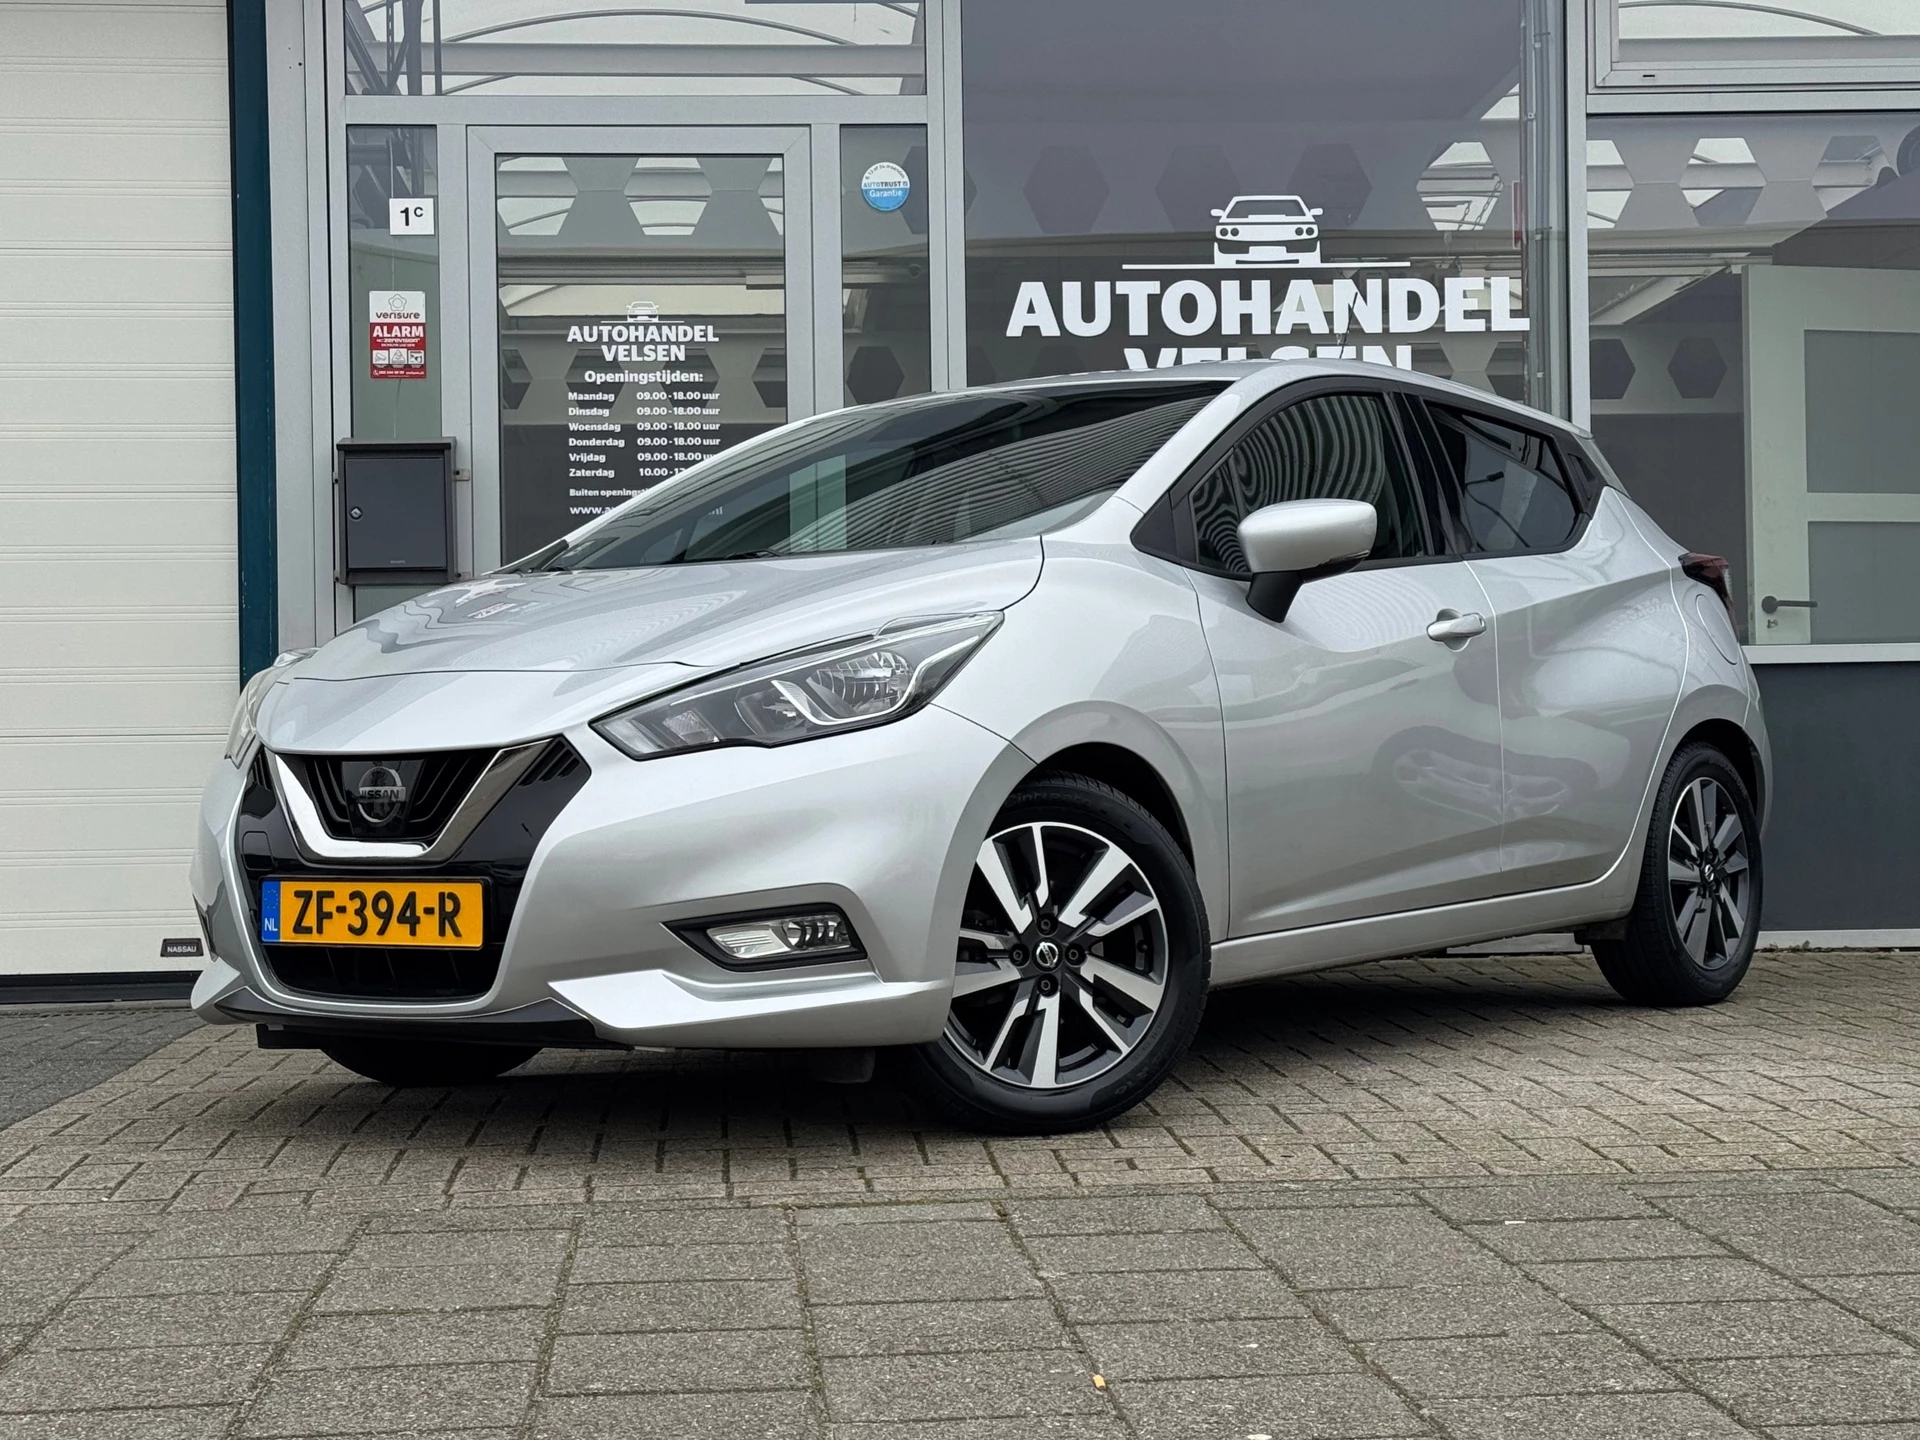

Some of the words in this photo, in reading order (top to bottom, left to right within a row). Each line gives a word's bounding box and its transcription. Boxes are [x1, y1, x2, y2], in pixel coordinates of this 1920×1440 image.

[869, 189, 903, 198] Garantie
[1006, 276, 1531, 337] AUTOHANDEL
[375, 311, 421, 319] verisure
[372, 325, 424, 338] ALARM
[567, 325, 720, 342] AUTOHANDEL
[601, 344, 686, 362] VELSEN
[584, 370, 704, 385] Openingstijden:
[568, 392, 615, 402] Maandag
[636, 391, 667, 400] 09.00
[673, 391, 701, 400] 18.00
[568, 407, 610, 417] Dinsdag
[636, 406, 667, 415] 09.00
[673, 406, 701, 415] 18.00
[569, 422, 621, 432] Woensdag
[636, 422, 667, 430] 09.00
[673, 422, 701, 430] 18.00
[568, 438, 625, 448] Donderdag
[636, 437, 667, 445] 09.00
[673, 437, 701, 445] 18.00
[569, 453, 606, 463] Vrijdag
[637, 452, 668, 461] 09.00
[674, 452, 701, 461] 18.00
[569, 468, 615, 478] Zaterdag
[639, 467, 668, 477] 10.00
[569, 488, 599, 497] Buiten
[292, 889, 462, 938] ZF-394-R
[264, 921, 278, 932] NL
